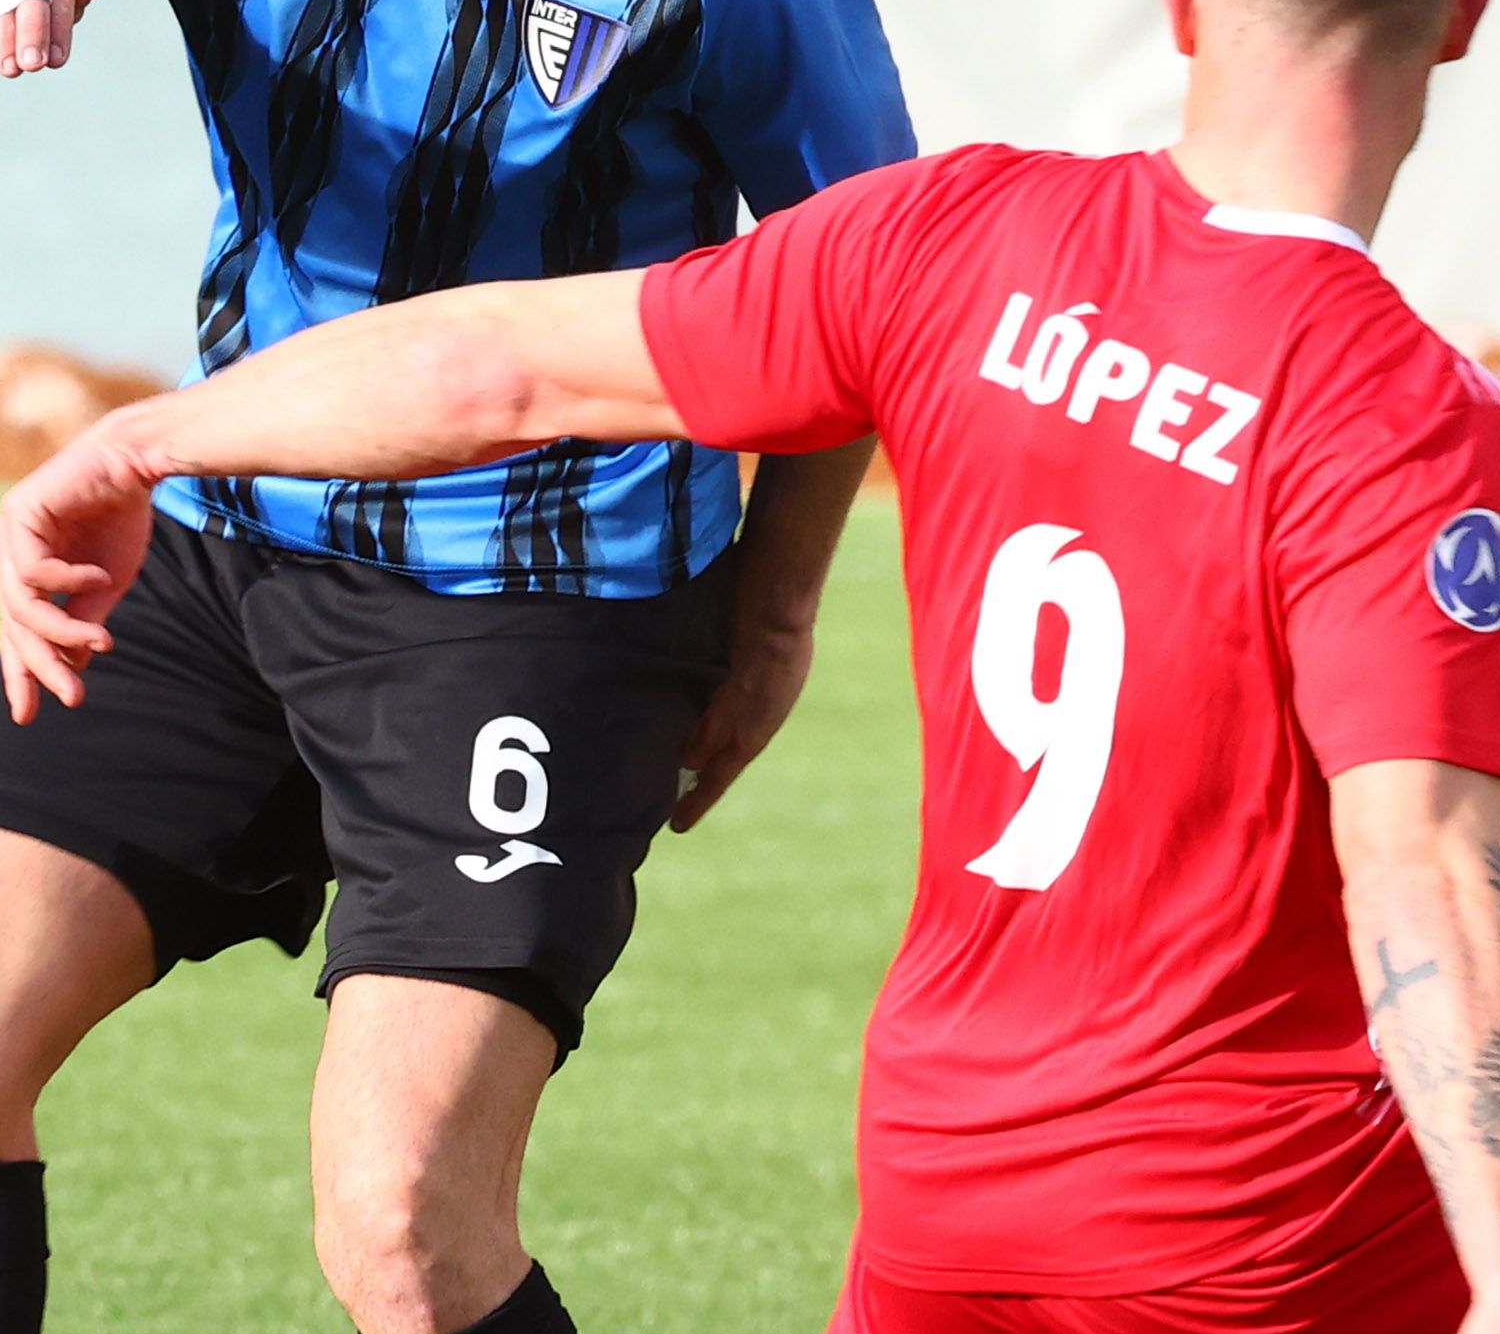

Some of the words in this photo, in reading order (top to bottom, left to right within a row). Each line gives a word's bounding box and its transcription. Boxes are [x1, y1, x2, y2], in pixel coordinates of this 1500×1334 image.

[978, 291, 1263, 486] LÓPEZ
[468, 715, 552, 835] 6
[964, 522, 1127, 892] 9
